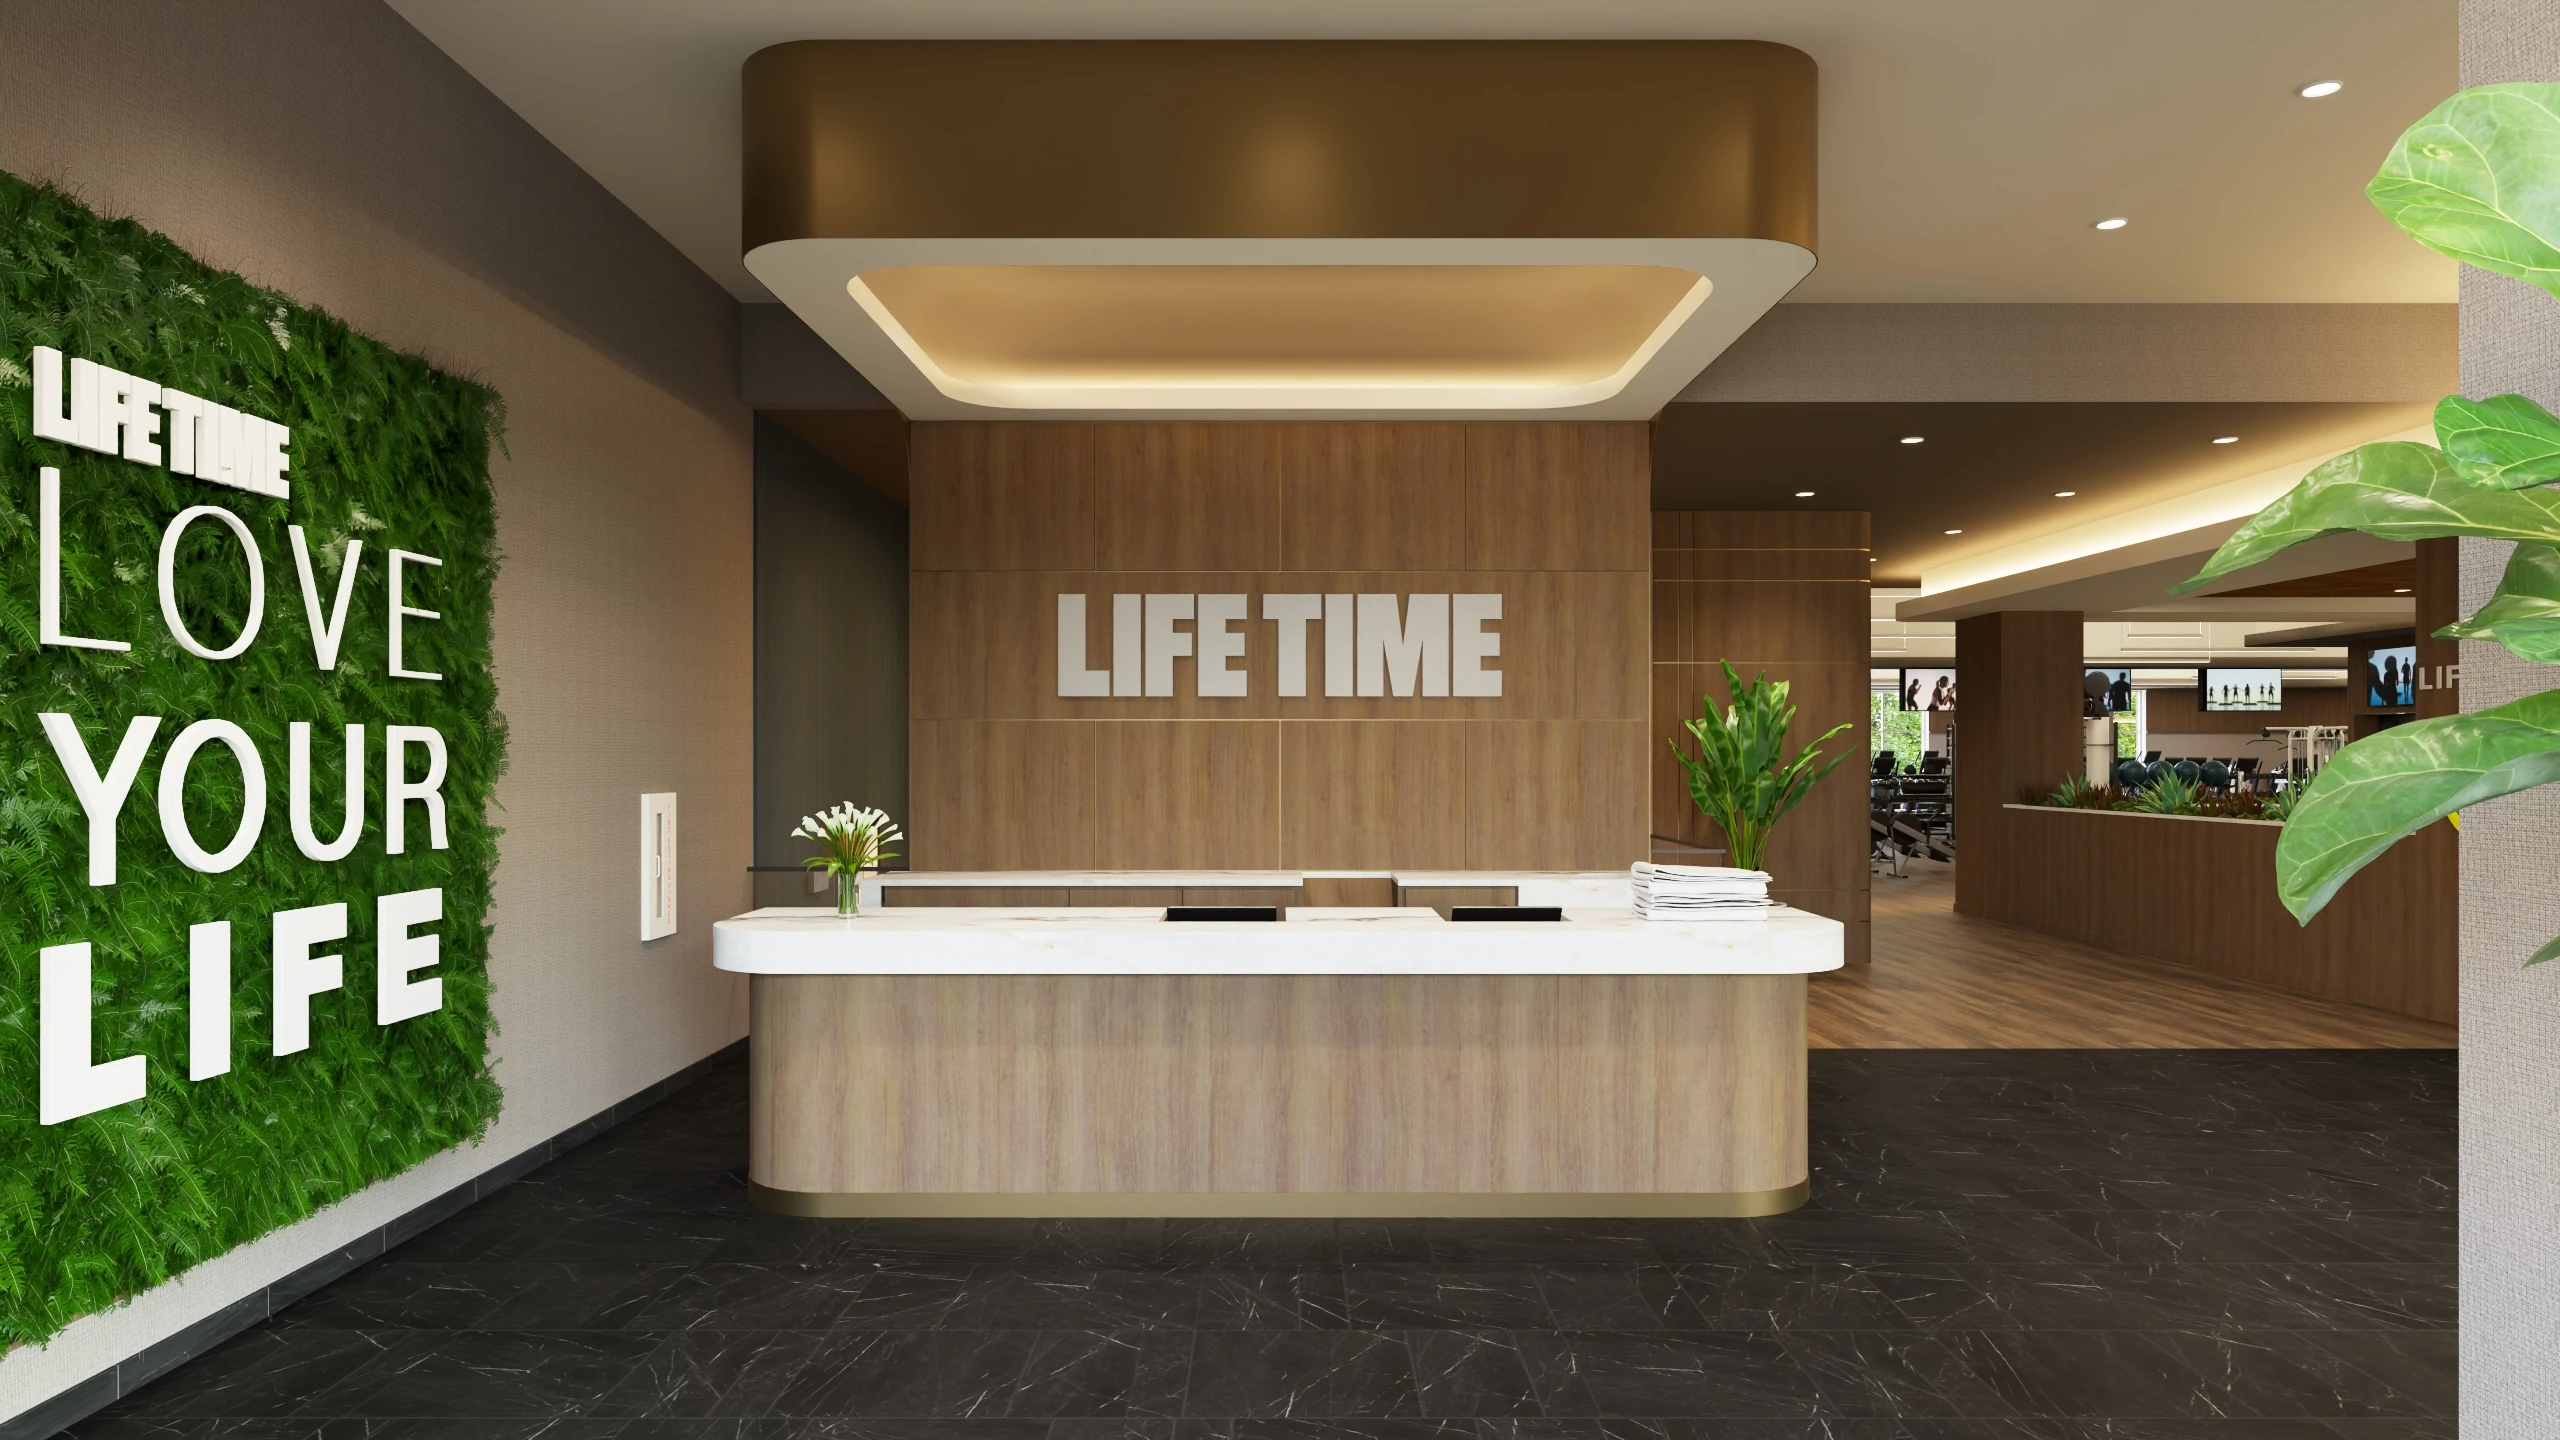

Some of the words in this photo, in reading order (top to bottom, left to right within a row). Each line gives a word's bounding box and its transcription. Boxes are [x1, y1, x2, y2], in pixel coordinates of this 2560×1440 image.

[33, 345, 162, 467] LIFE
[161, 387, 290, 500] TIME
[40, 466, 443, 681] LOVE
[1057, 593, 1248, 697] LIFE
[1262, 593, 1503, 697] TIME
[37, 712, 449, 887] YOUR
[40, 887, 443, 1126] LIFE
